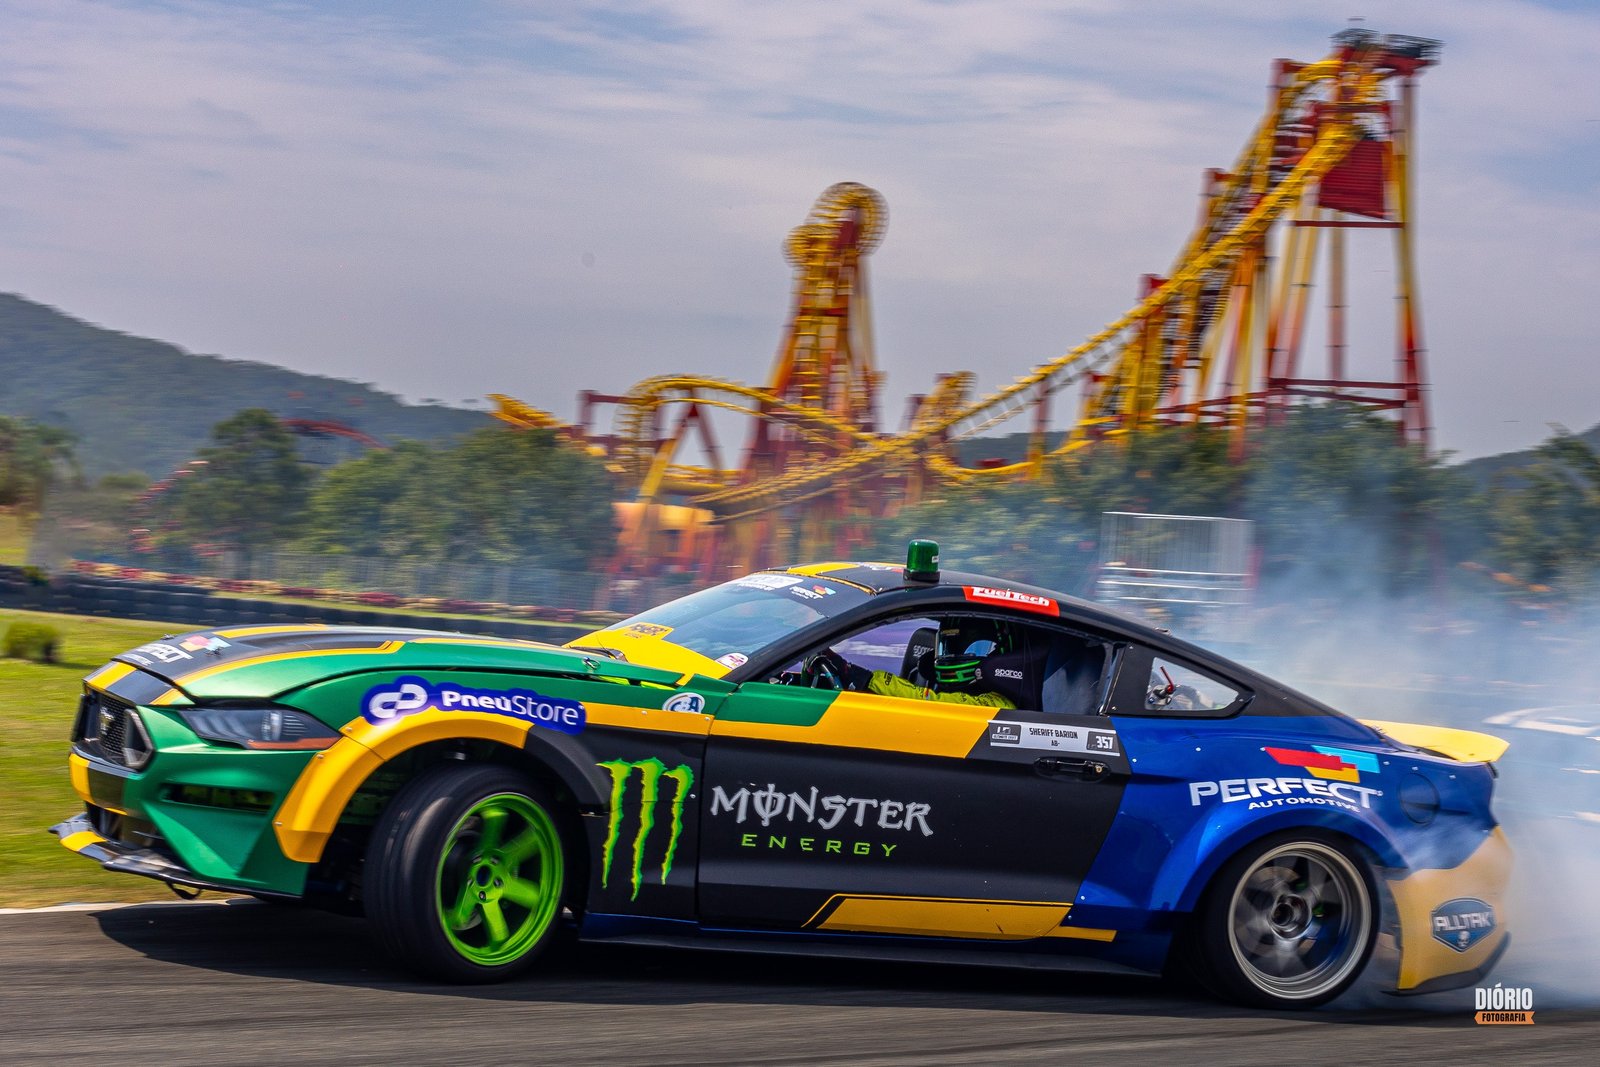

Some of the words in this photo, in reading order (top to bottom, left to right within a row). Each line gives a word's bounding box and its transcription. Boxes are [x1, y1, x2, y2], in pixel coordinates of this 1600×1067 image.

[971, 586, 1050, 607] FuelTech
[994, 668, 1023, 680] sparco
[442, 690, 579, 726] PneuStore
[1029, 727, 1054, 738] SHERIFF
[1055, 729, 1078, 740] BARION
[1095, 735, 1114, 750] 357
[1189, 777, 1377, 809] PERFECT
[710, 783, 934, 836] MONSTER
[1248, 796, 1361, 814] AUTOMOTIVE
[741, 833, 897, 857] ENERGY
[1434, 912, 1491, 932] ALLTAK
